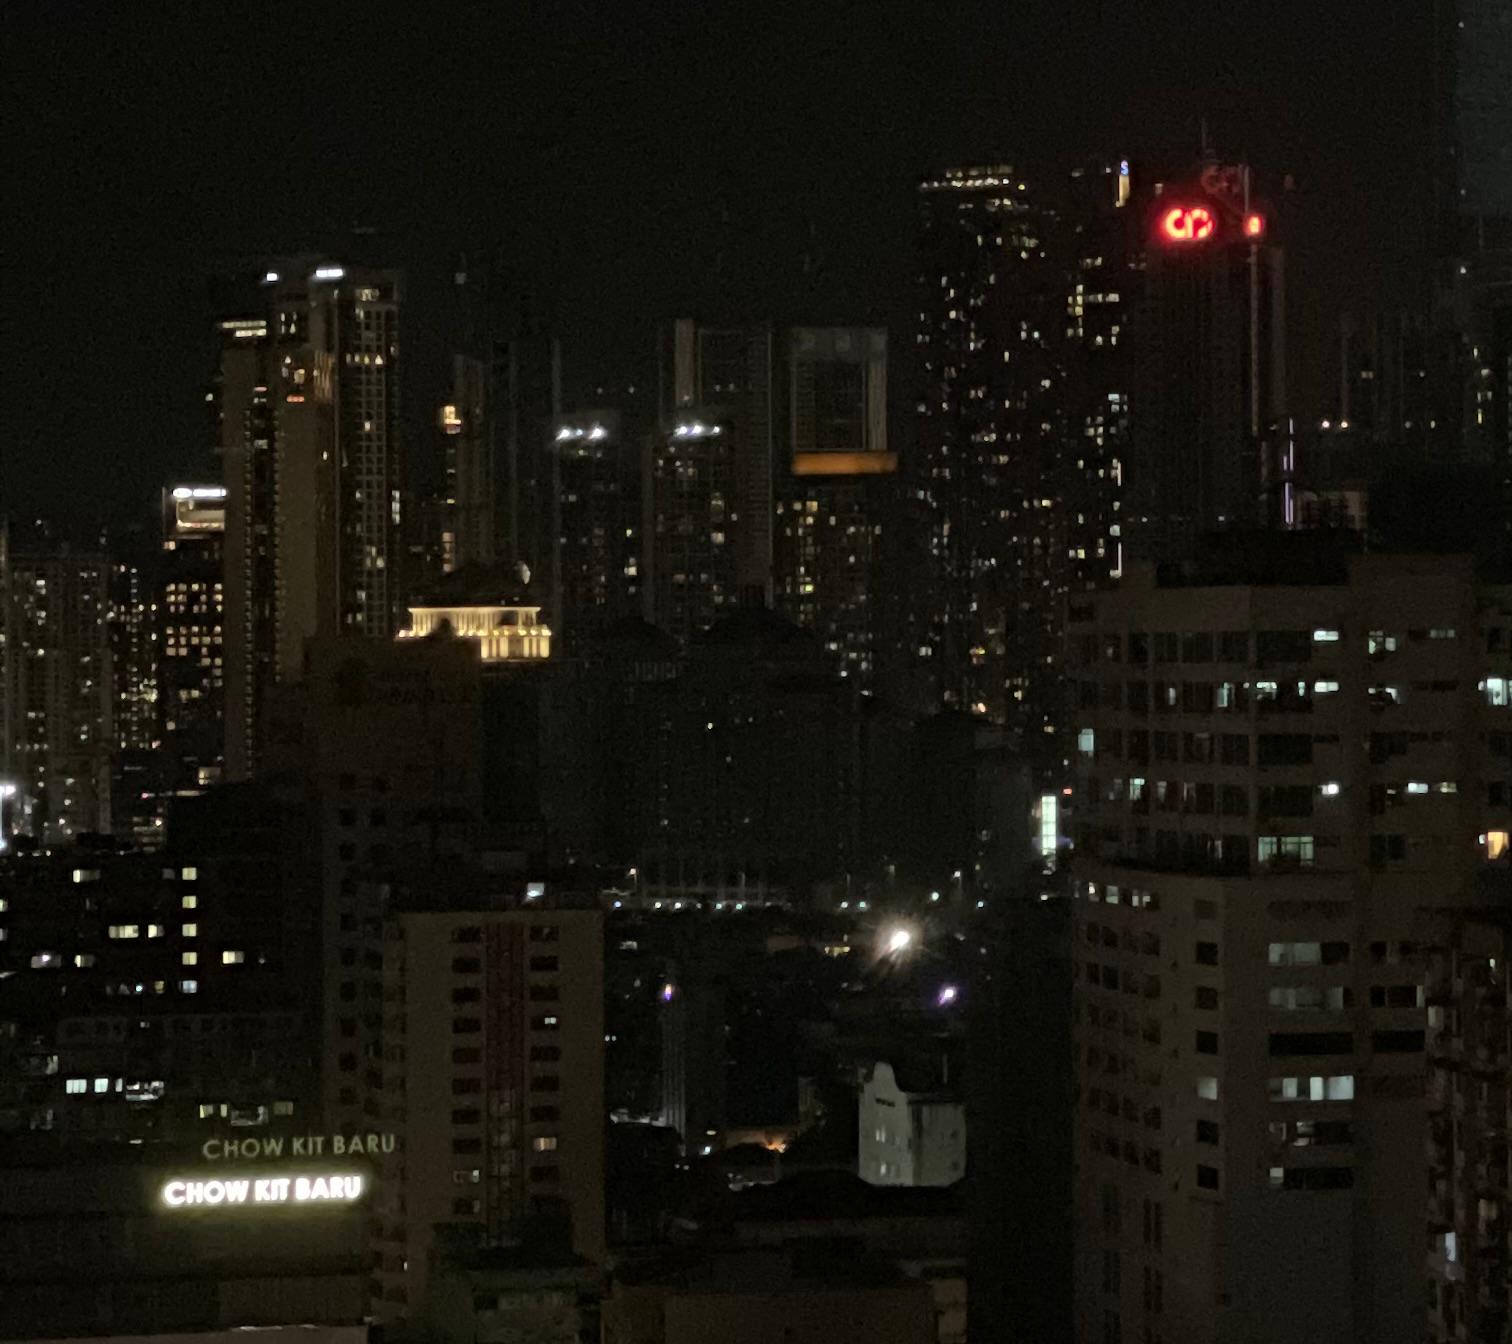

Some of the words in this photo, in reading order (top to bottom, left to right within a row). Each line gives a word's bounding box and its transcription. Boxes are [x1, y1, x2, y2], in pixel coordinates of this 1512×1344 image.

[202, 1138, 284, 1159] CHOW
[292, 1136, 325, 1156] KIT
[333, 1134, 395, 1154] BARU
[163, 1179, 249, 1205] CHOW
[254, 1177, 291, 1201] KIT
[295, 1174, 362, 1200] BARU
